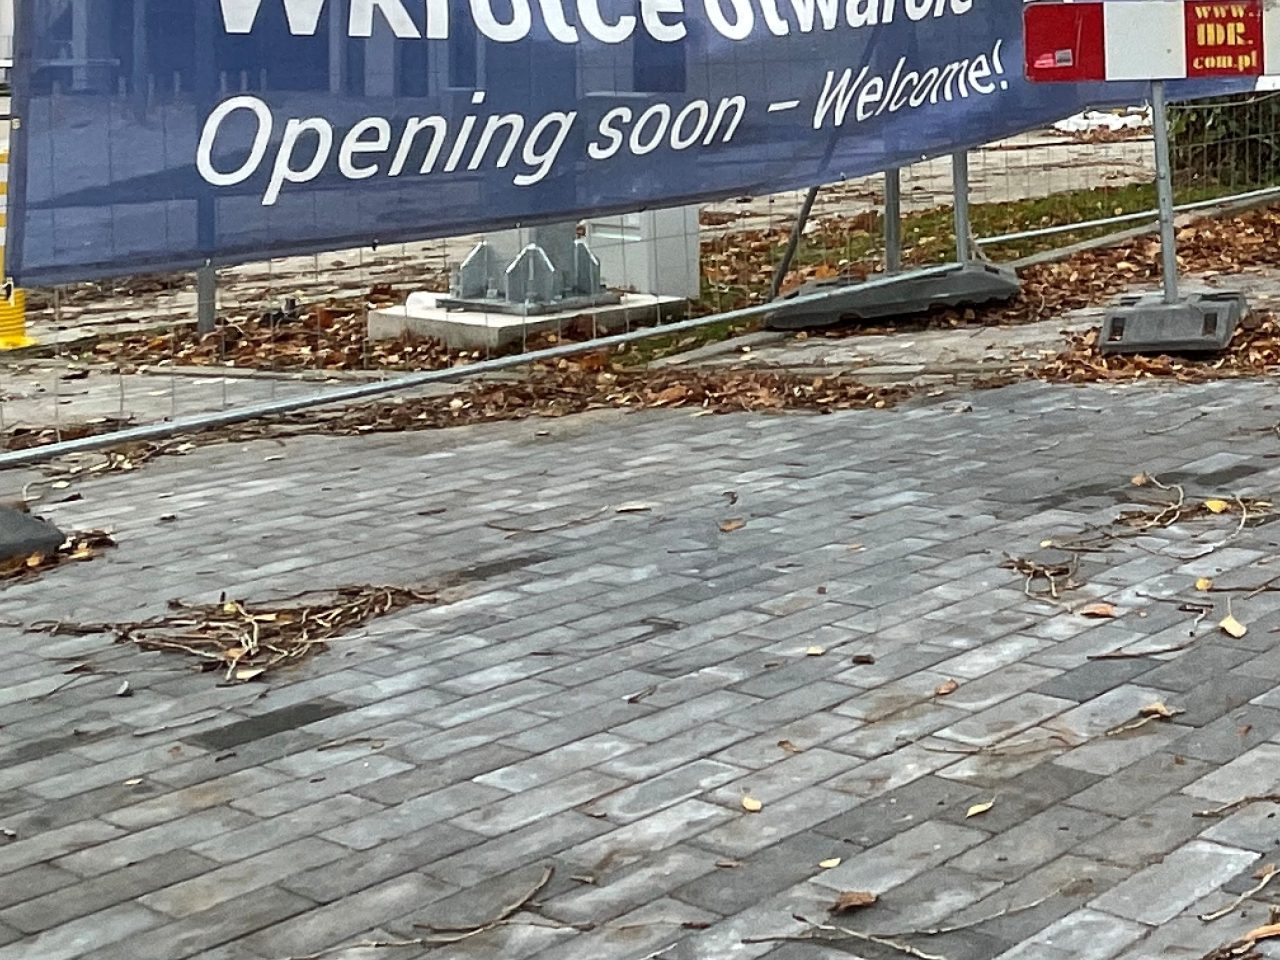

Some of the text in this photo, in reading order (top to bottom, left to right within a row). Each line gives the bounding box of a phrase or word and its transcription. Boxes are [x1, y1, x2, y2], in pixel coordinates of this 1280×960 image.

[1193, 51, 1257, 72] com.pl
[196, 91, 577, 207] Opening
[587, 95, 747, 160] soon
[812, 38, 1010, 131] Welcome!
